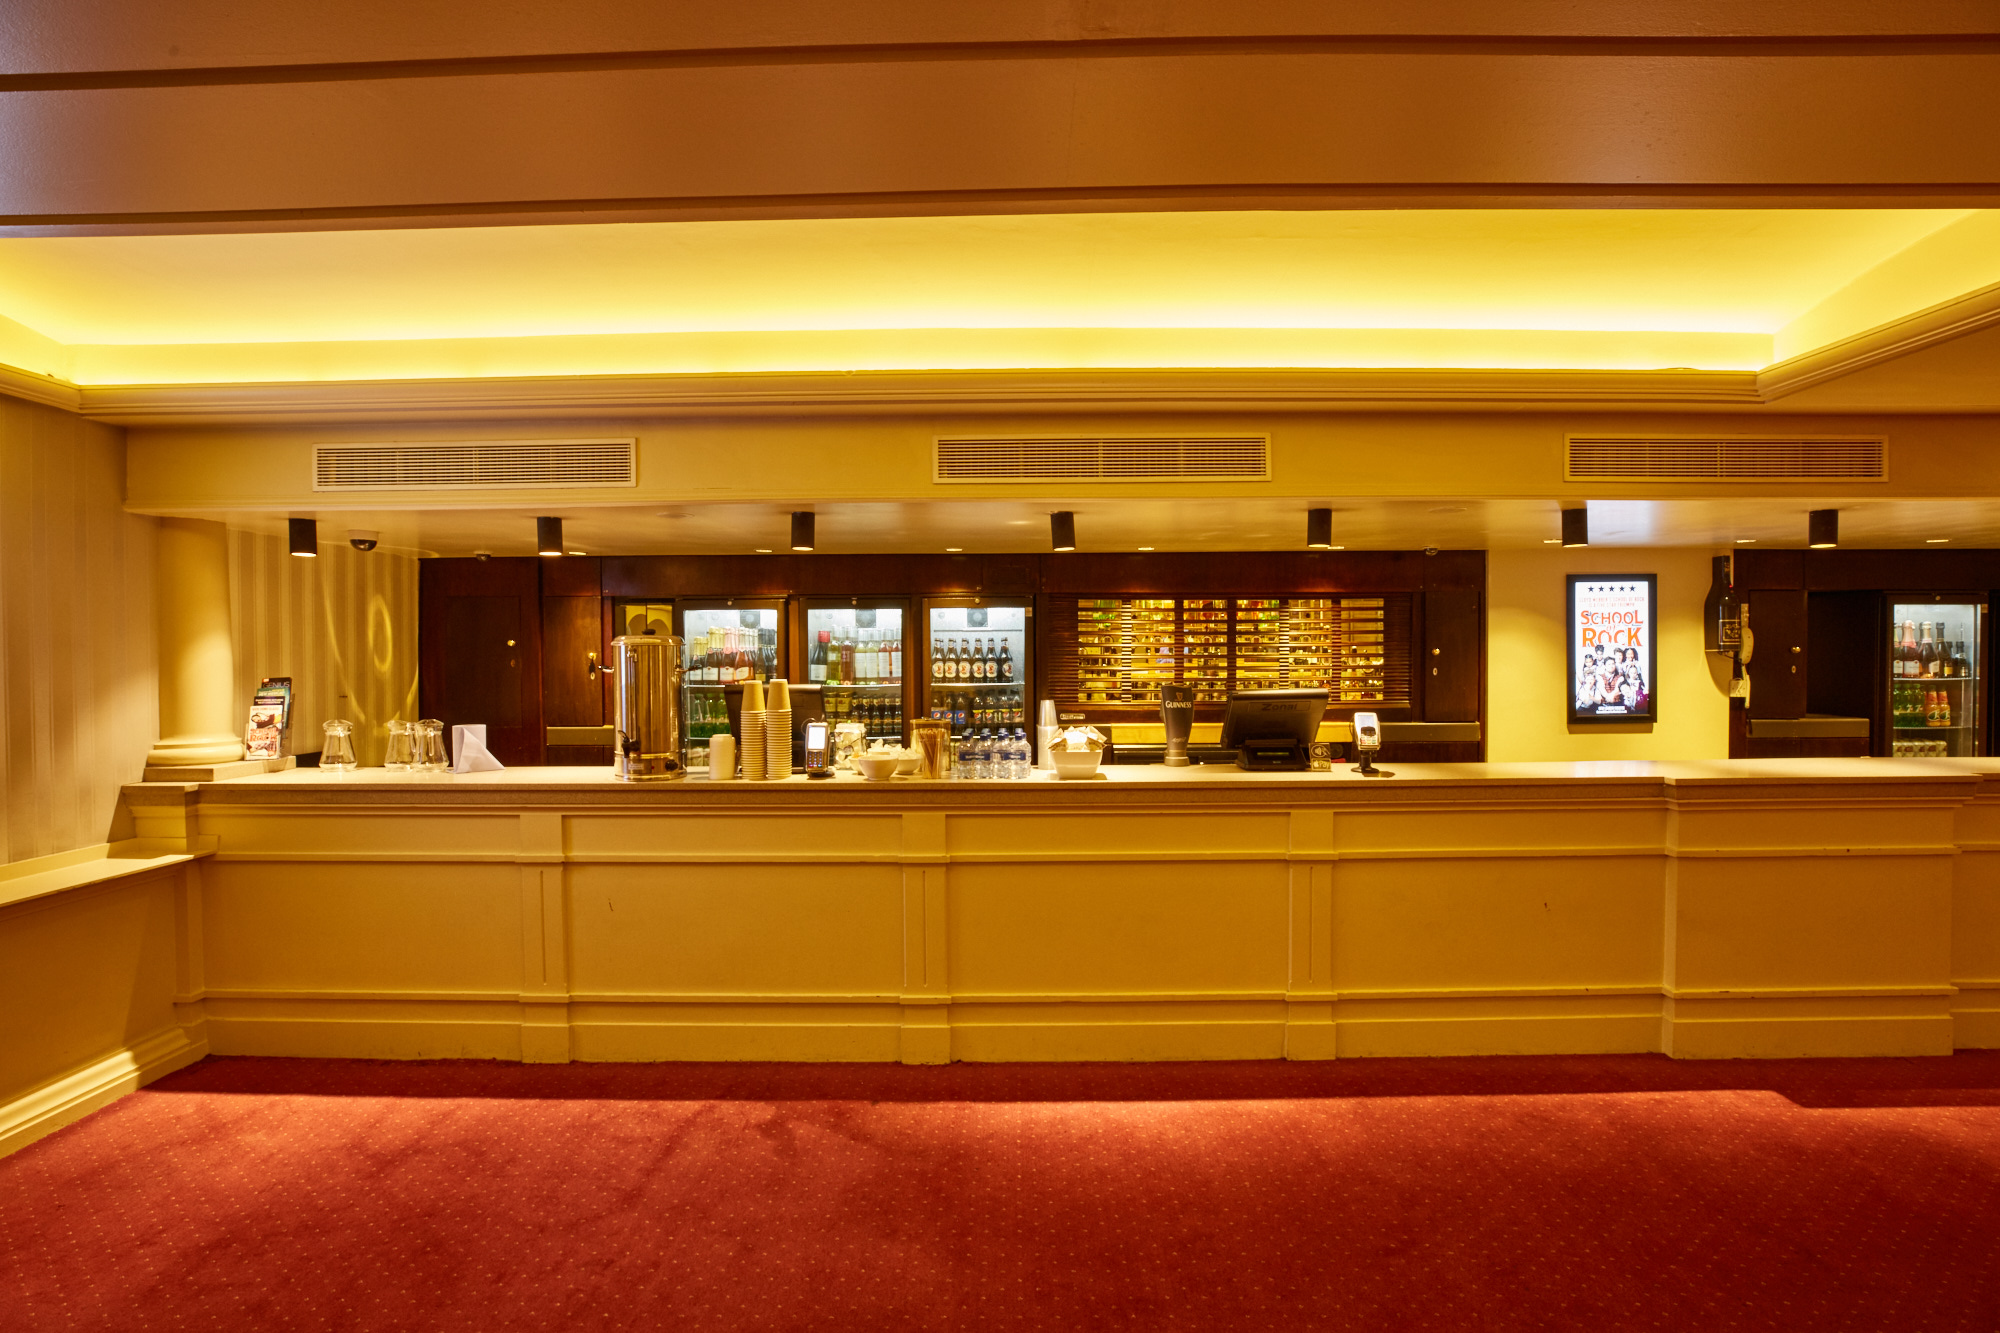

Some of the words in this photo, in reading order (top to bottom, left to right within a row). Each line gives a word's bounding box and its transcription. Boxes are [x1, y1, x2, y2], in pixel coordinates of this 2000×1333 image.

[1581, 610, 1643, 625] SCHOOL
[1582, 627, 1643, 647] ROCK
[1165, 700, 1192, 709] GUINNESS
[1319, 760, 1330, 769] Pay
